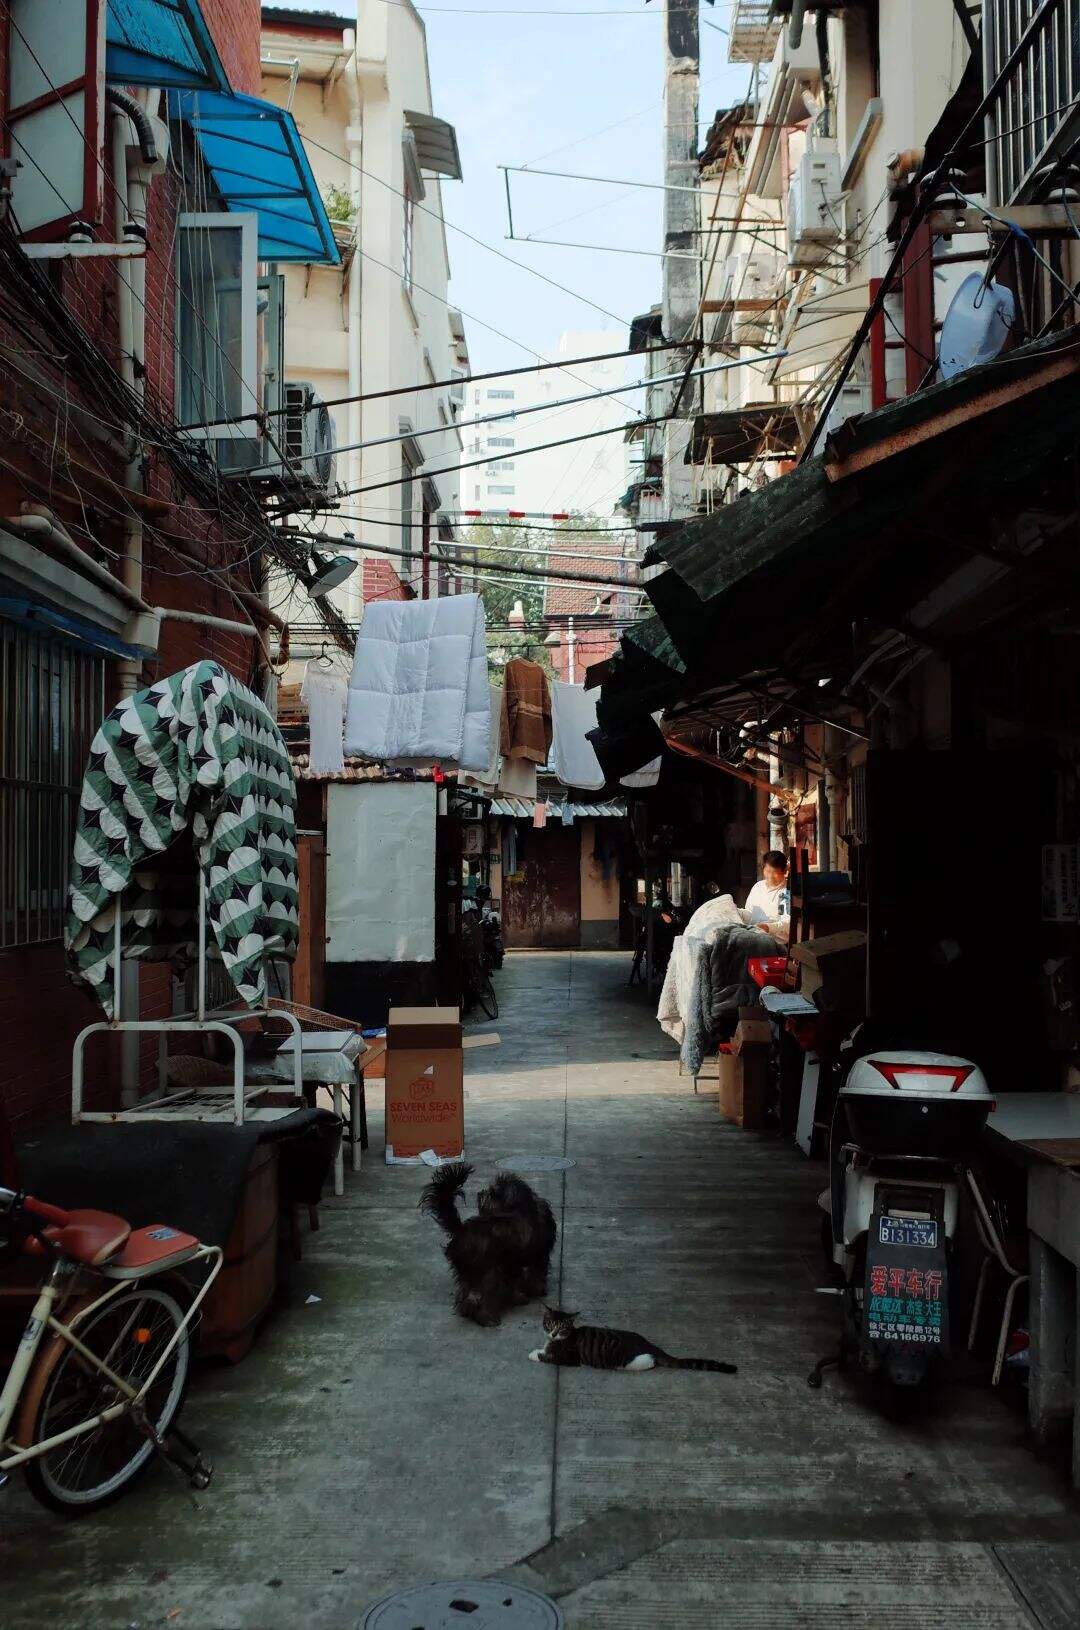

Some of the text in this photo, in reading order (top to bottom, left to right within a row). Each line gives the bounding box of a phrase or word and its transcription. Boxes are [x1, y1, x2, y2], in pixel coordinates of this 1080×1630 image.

[390, 1102, 457, 1112] SEVEN SEAS
[881, 1228, 935, 1246] B131334
[870, 1265, 942, 1300] 爱平车行
